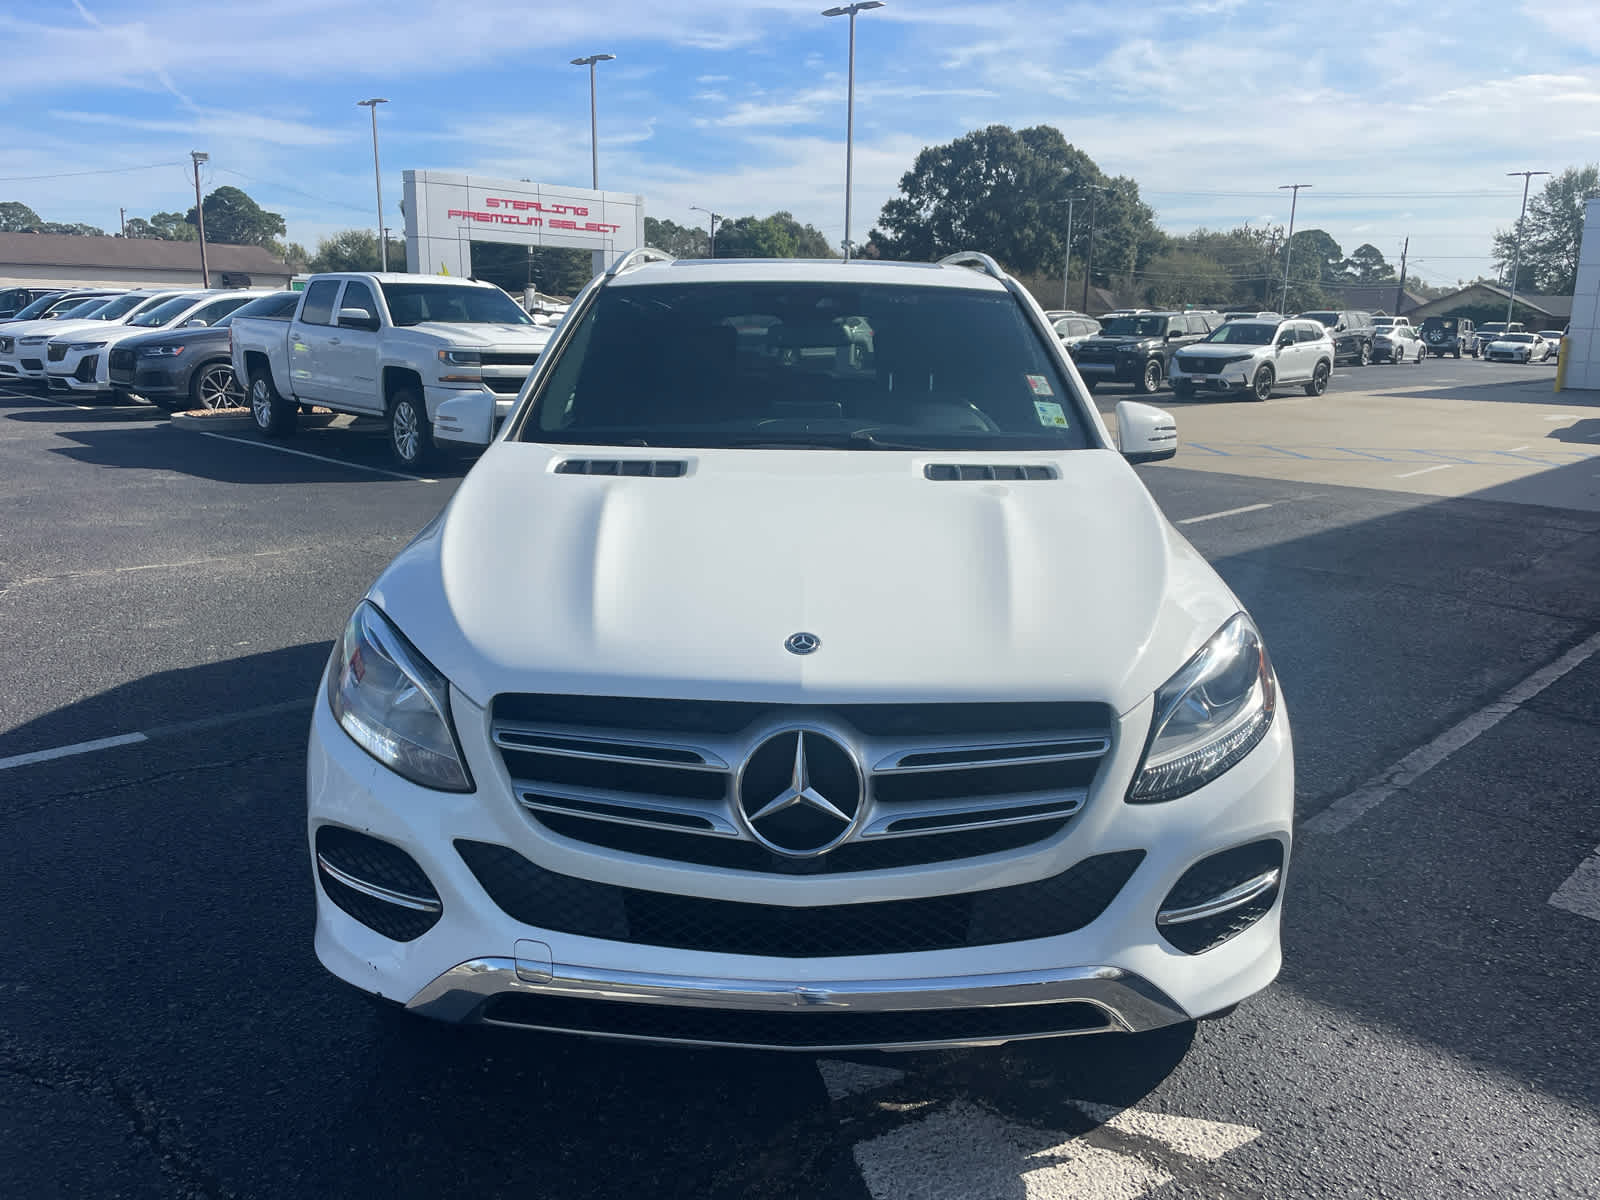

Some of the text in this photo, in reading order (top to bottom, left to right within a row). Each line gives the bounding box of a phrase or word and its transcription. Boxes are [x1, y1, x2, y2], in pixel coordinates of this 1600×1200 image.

[486, 197, 588, 216] STERLING
[448, 209, 621, 233] PREMIUM SELECT
